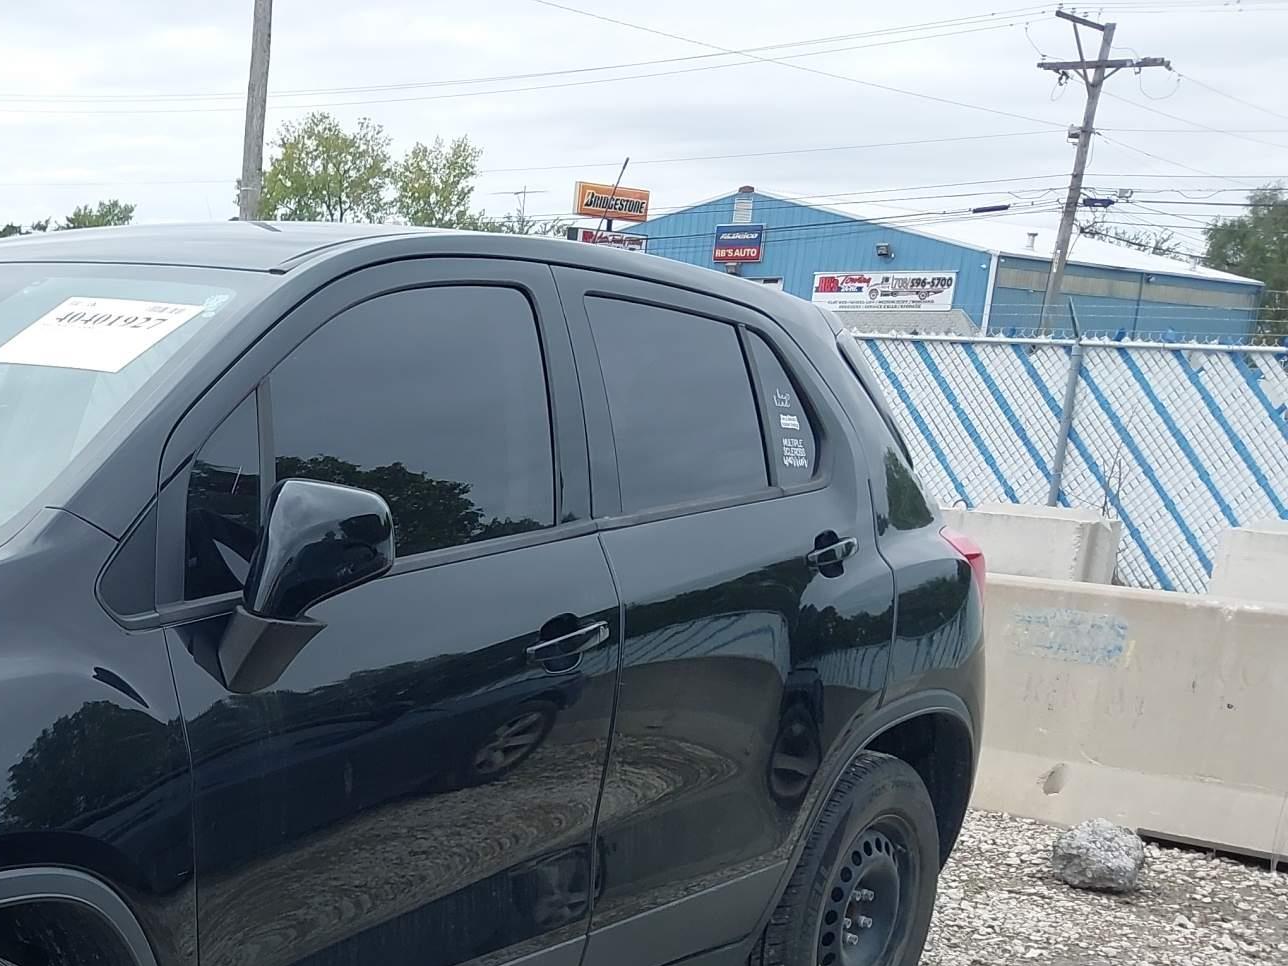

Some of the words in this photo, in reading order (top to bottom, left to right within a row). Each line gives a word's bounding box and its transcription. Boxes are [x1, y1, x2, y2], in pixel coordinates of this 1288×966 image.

[584, 190, 646, 214] BRIDGESTONE
[734, 247, 757, 257] AUTO
[910, 276, 953, 288] 596-5700
[55, 311, 169, 329] 40401927
